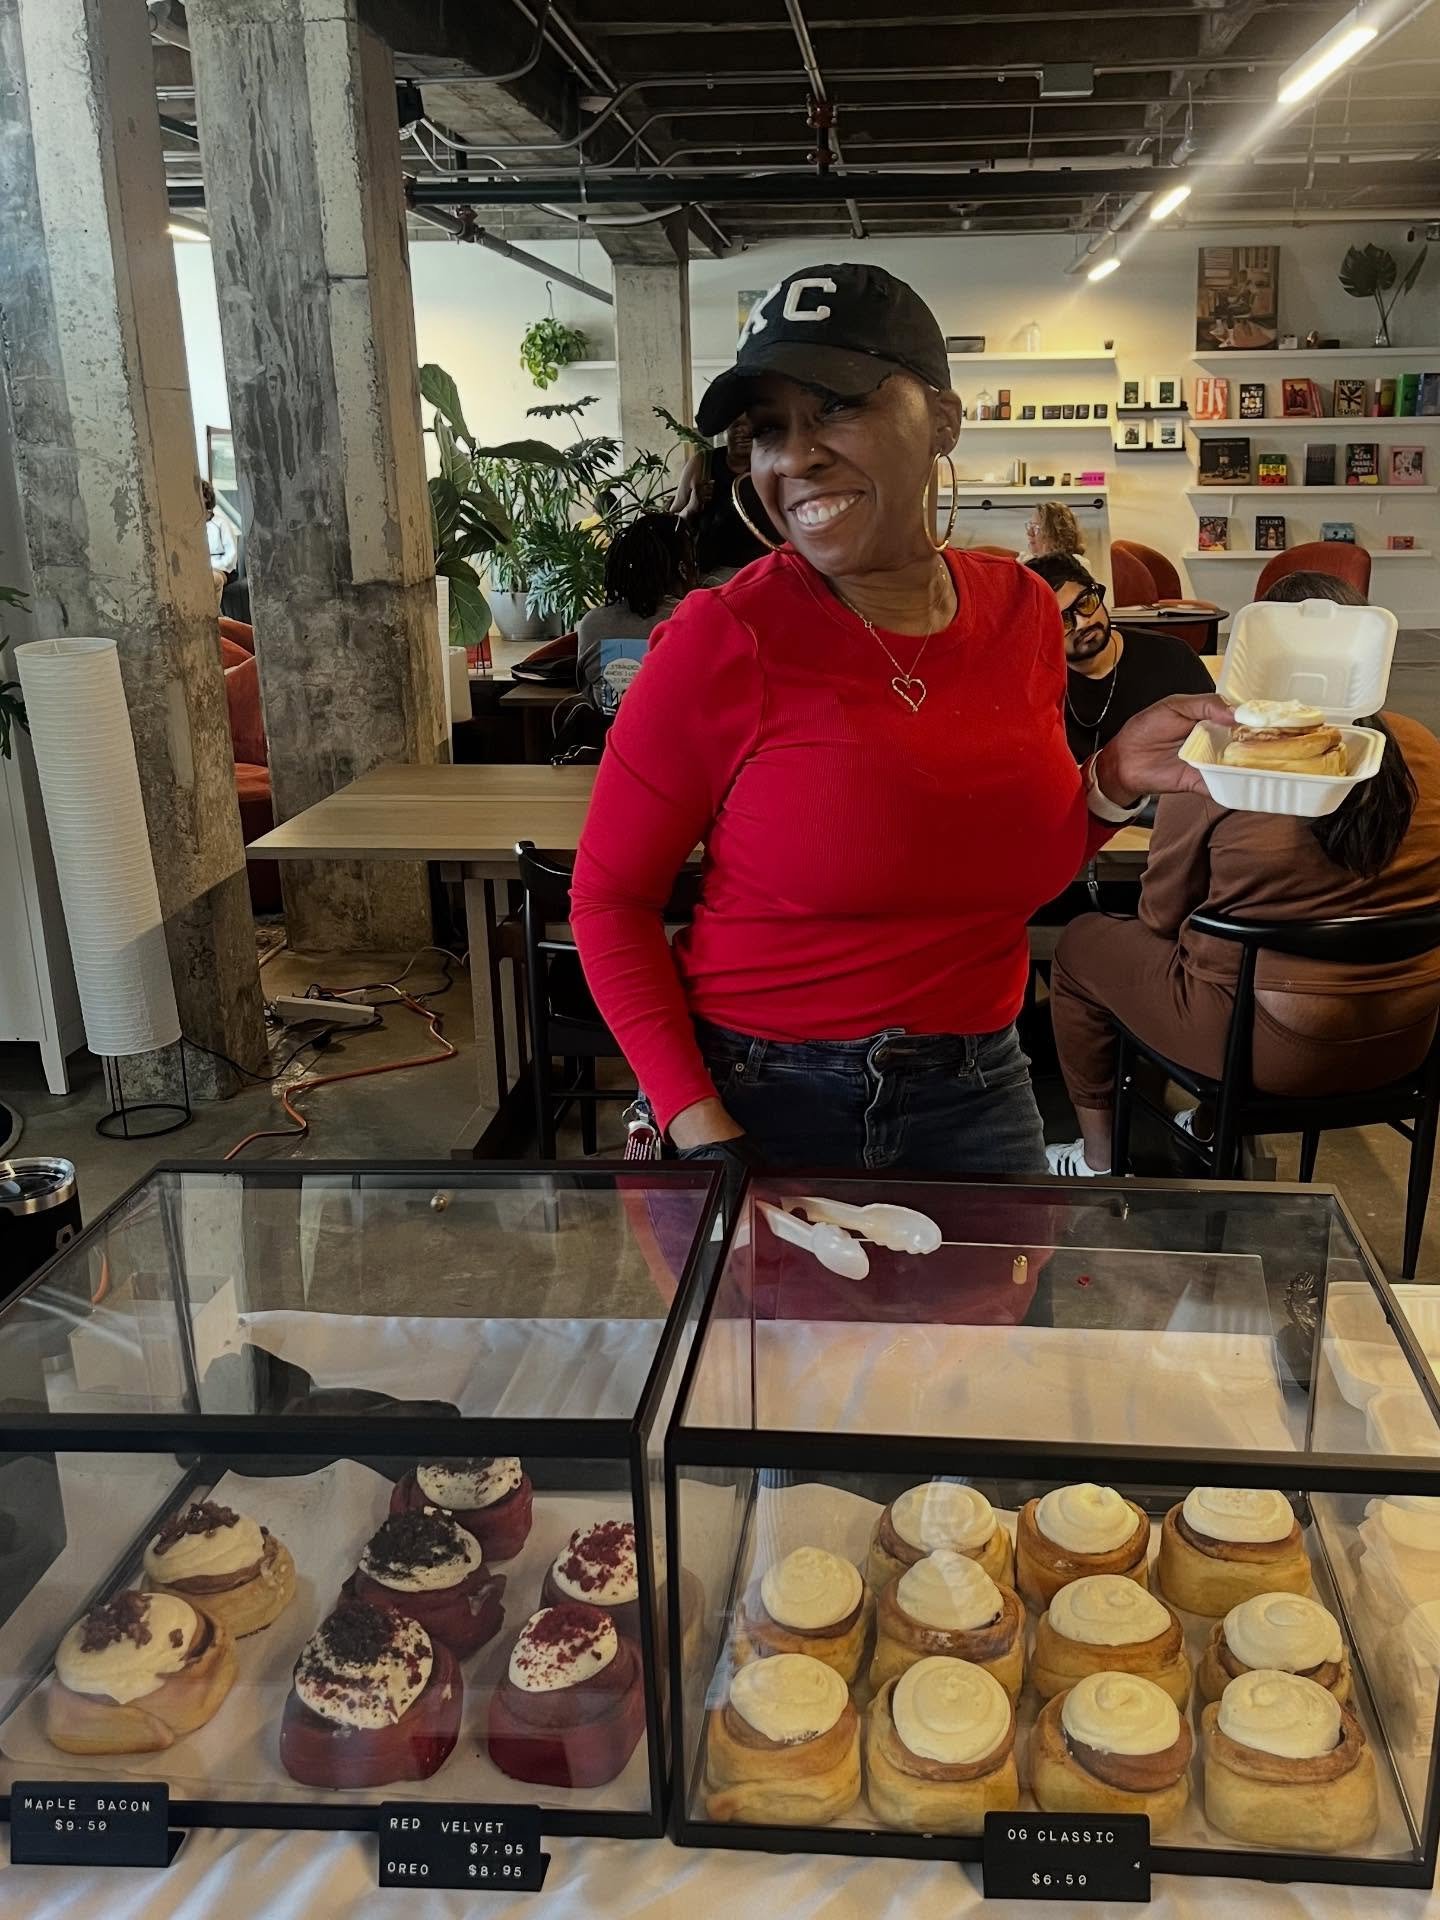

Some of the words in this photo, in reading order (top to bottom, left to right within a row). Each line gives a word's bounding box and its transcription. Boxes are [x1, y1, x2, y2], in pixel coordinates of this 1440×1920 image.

[24, 1798, 77, 1811] MAPLE
[97, 1799, 151, 1812] BACON
[55, 1818, 107, 1831] $9.50
[390, 1817, 421, 1829] RED
[441, 1821, 504, 1833] VELVET
[1007, 1828, 1028, 1840] OG
[1037, 1830, 1114, 1843] CLASSIC
[469, 1842, 524, 1855] $7.95
[387, 1861, 429, 1875] OREO
[468, 1864, 522, 1877] $8.95
[1031, 1872, 1087, 1886] $6.50
